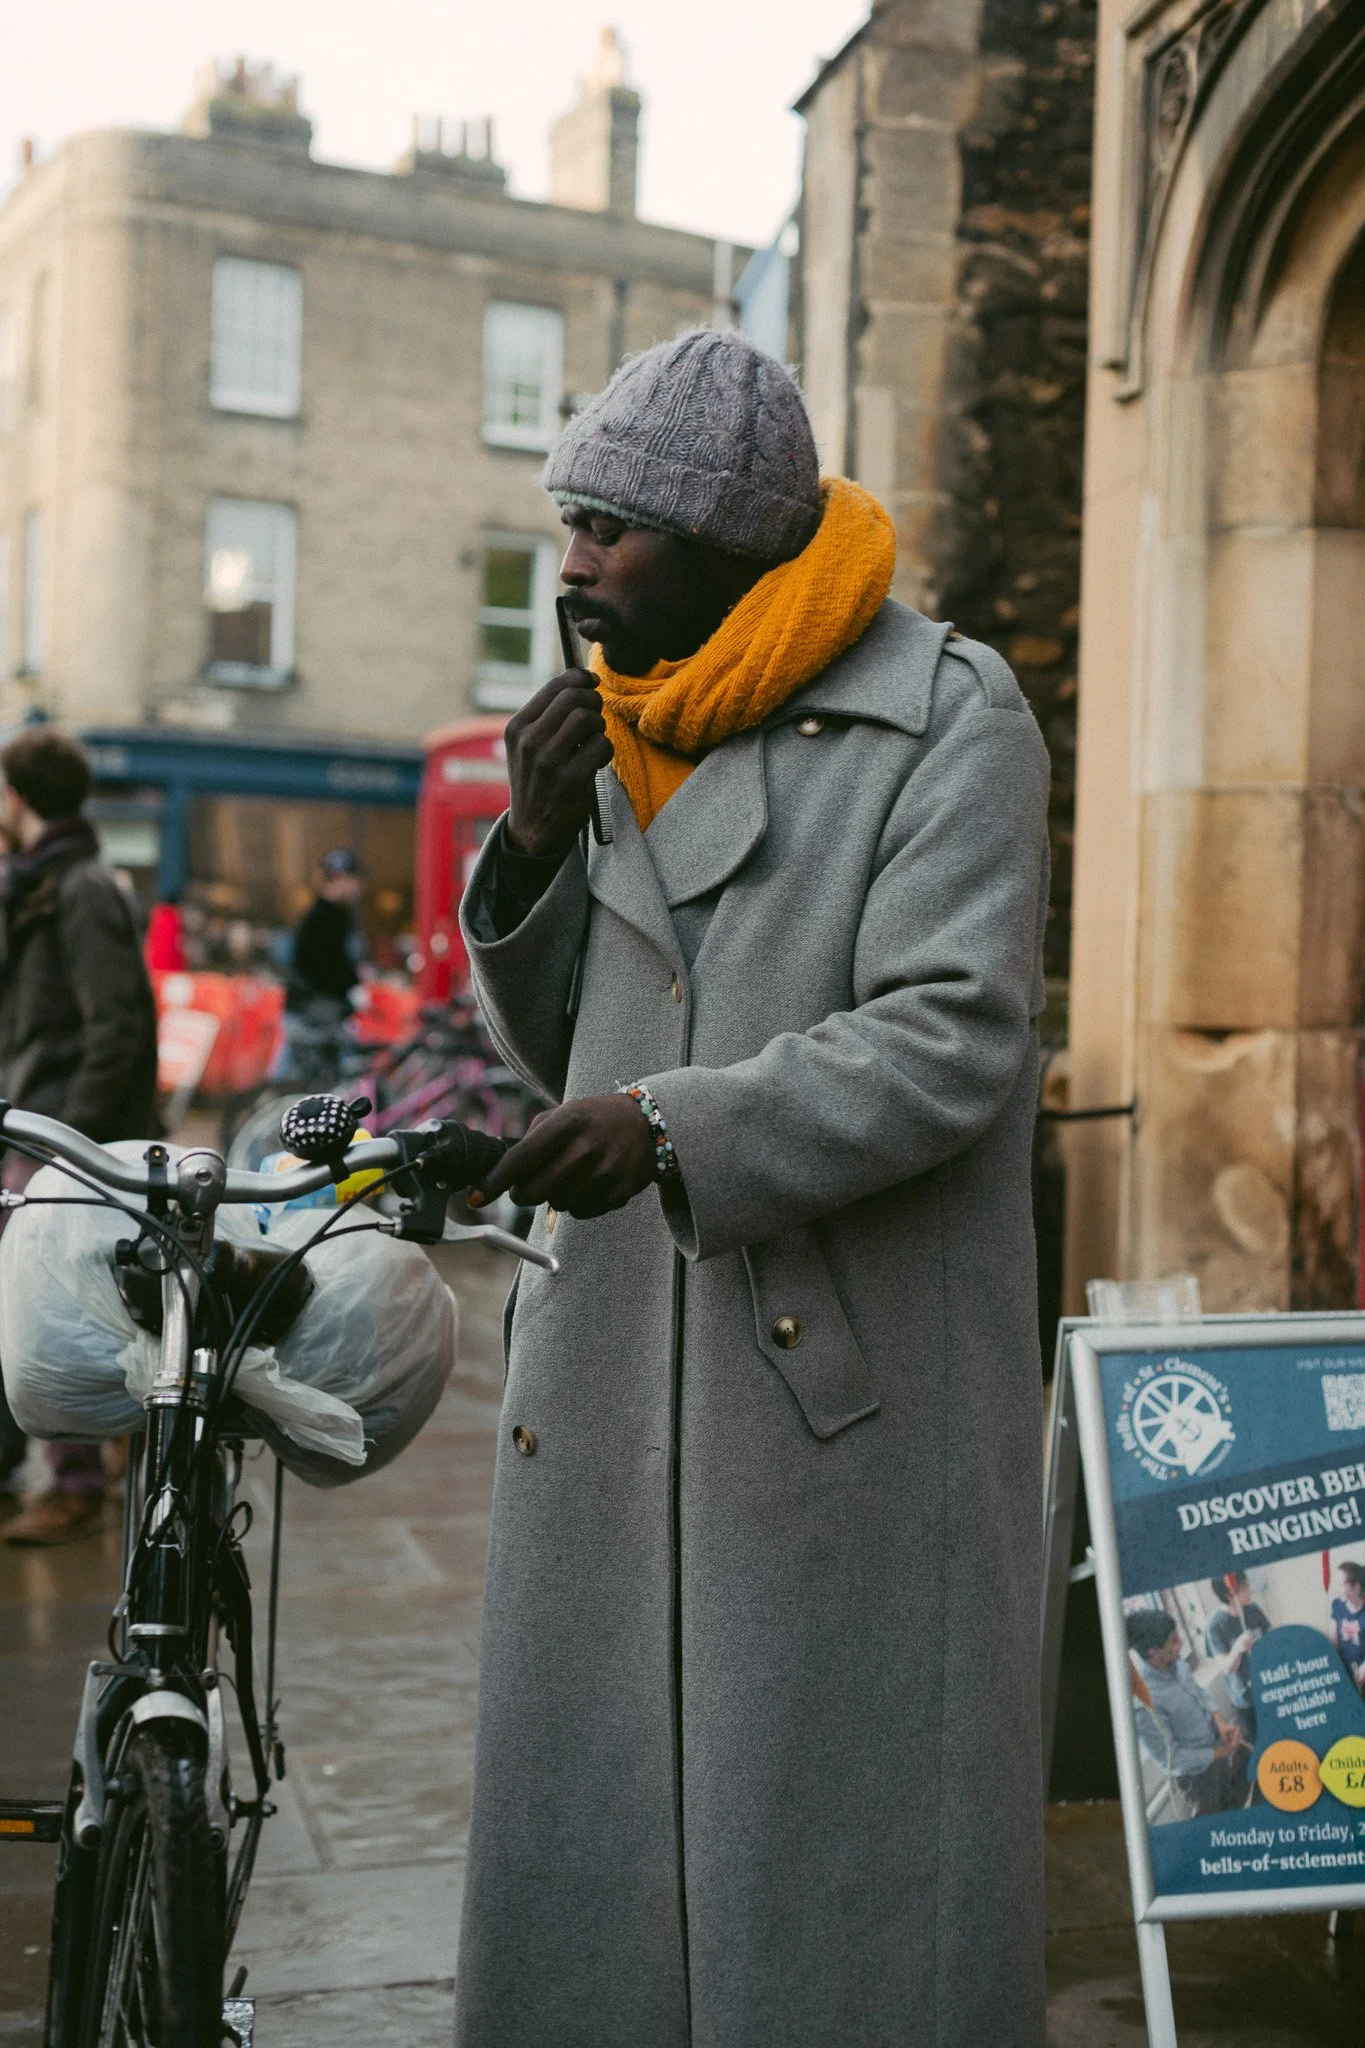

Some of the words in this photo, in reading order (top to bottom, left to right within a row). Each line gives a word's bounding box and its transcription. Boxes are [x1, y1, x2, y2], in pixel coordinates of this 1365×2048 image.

[1177, 1475, 1321, 1531] DISCOVER
[1227, 1496, 1362, 1555] RINGING!
[1260, 1655, 1329, 1685] Half-hour
[1261, 1670, 1341, 1704] experiences
[1276, 1689, 1337, 1718] available
[1294, 1711, 1328, 1731] here
[1270, 1761, 1310, 1774] Adults
[1279, 1775, 1305, 1793] £8
[1210, 1827, 1275, 1848] Monday
[1278, 1827, 1296, 1843] to
[1298, 1822, 1354, 1843] Friday,
